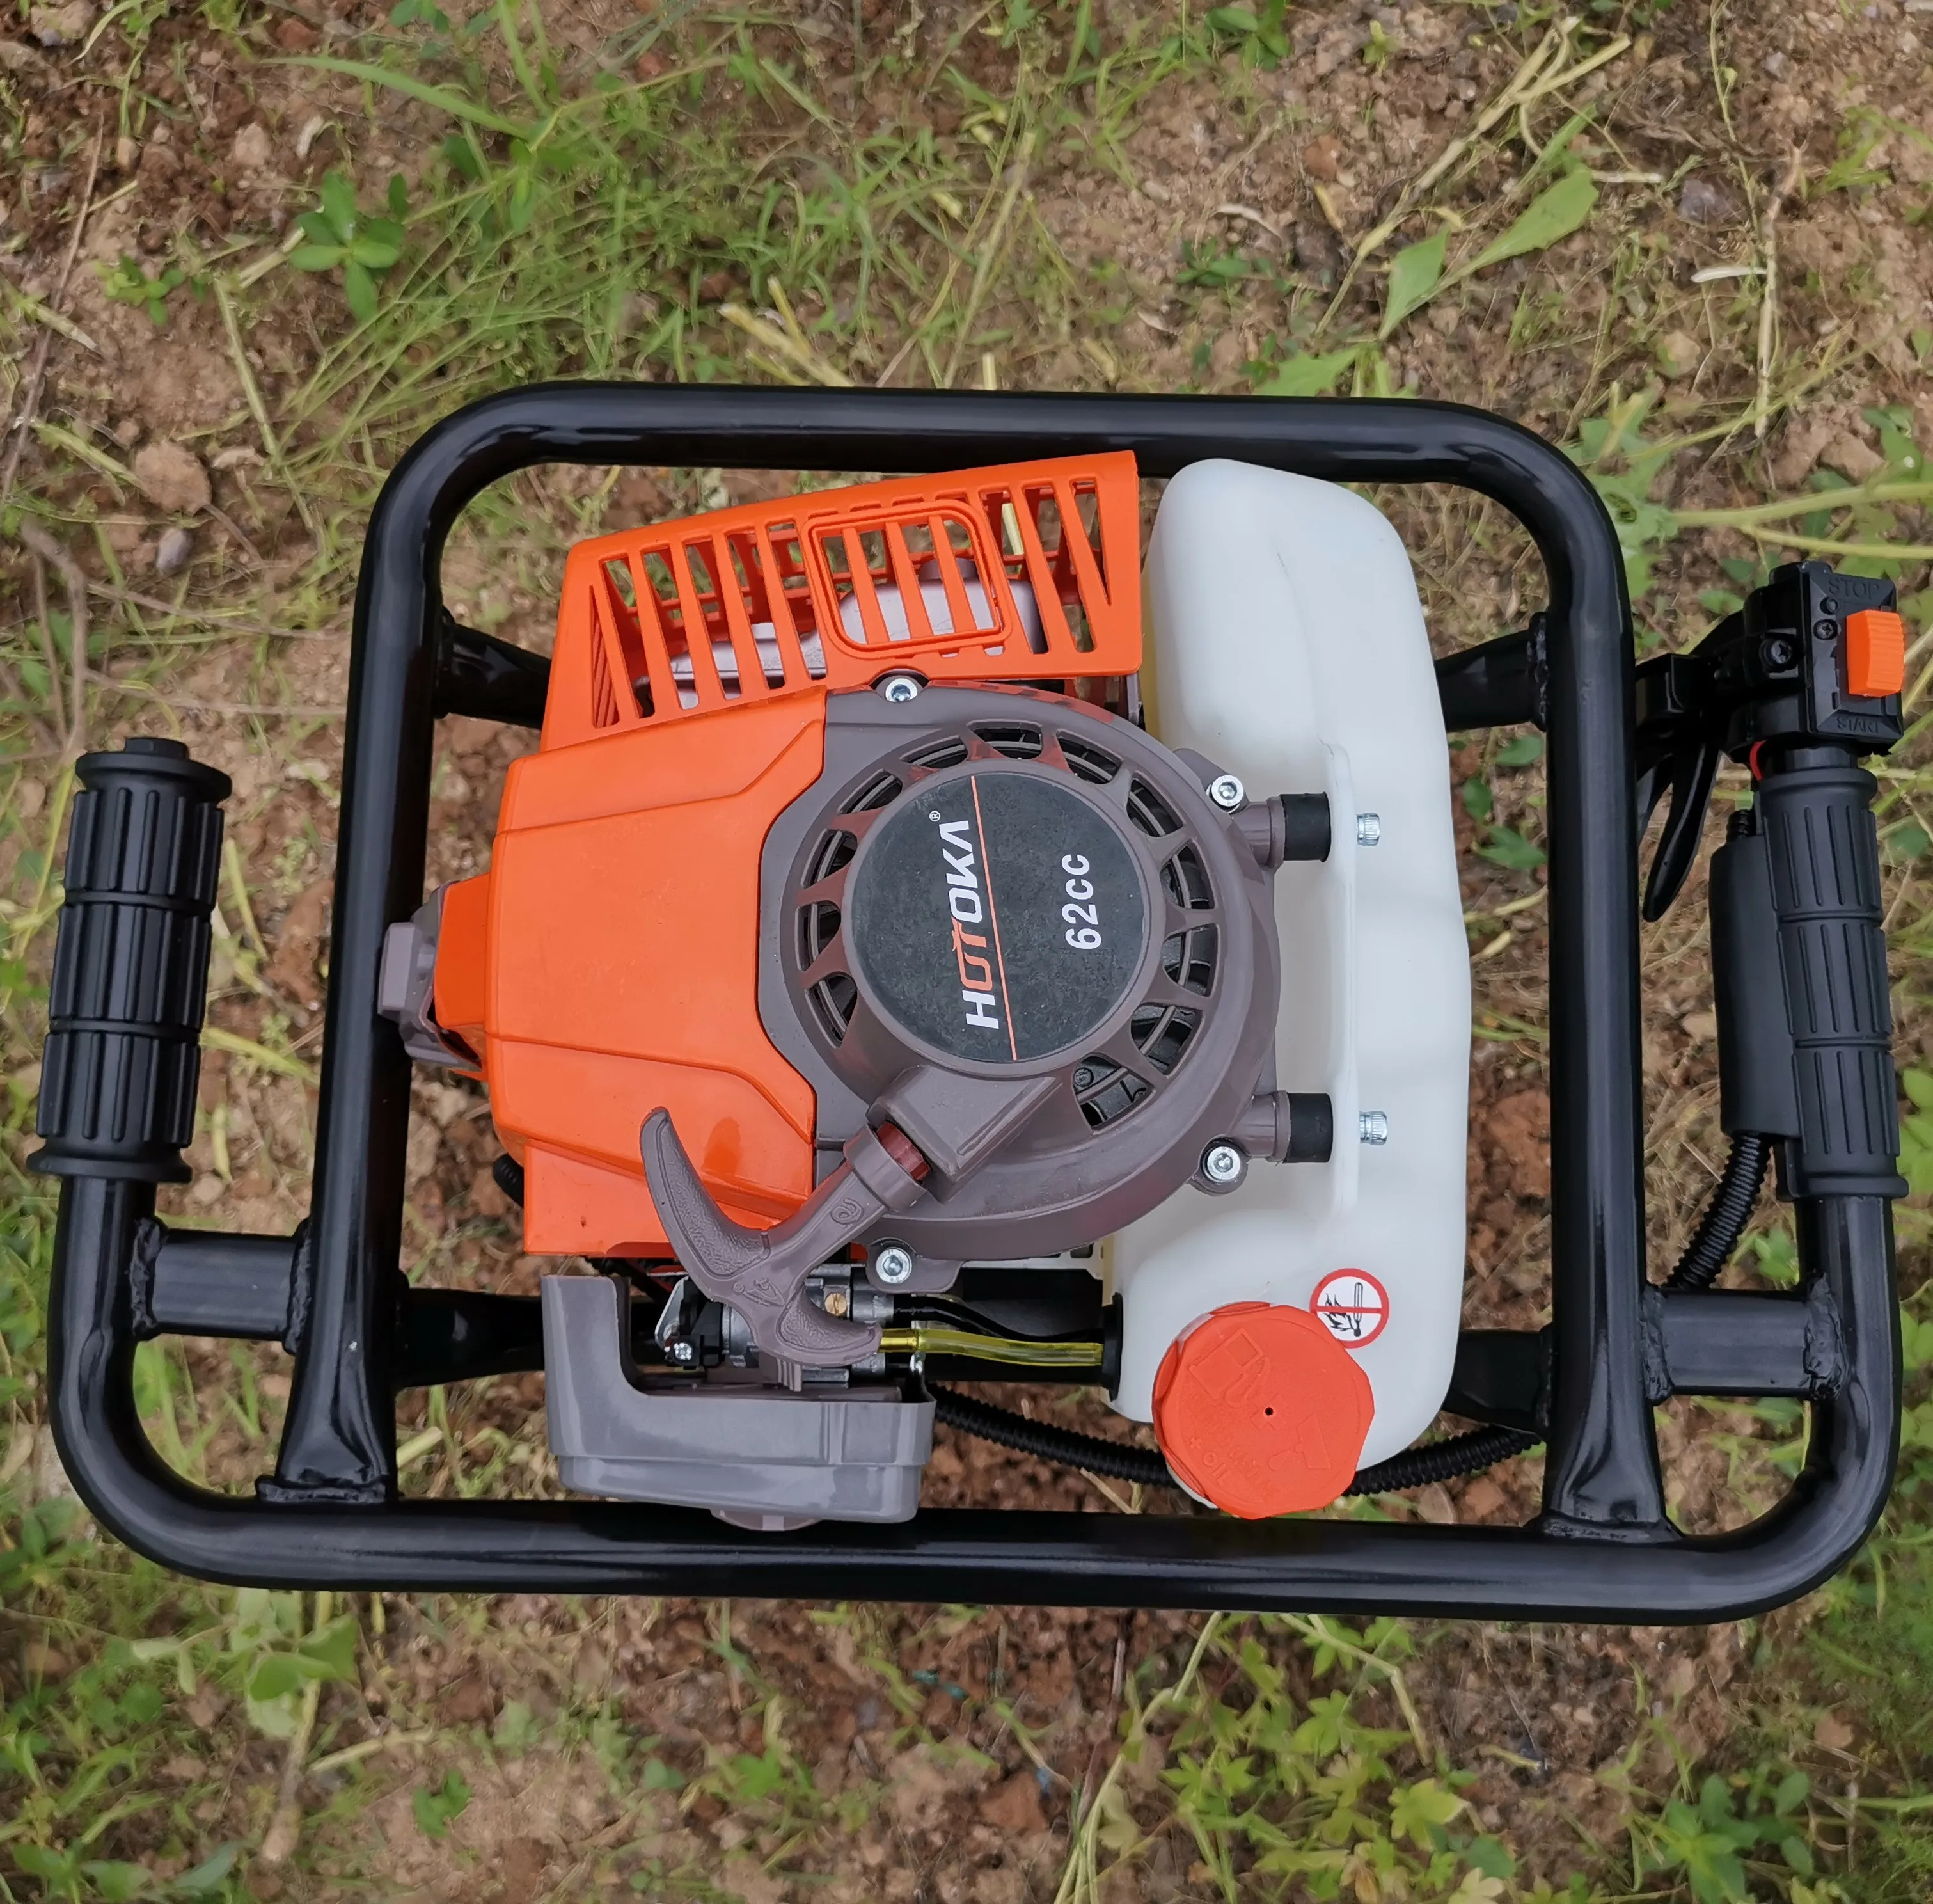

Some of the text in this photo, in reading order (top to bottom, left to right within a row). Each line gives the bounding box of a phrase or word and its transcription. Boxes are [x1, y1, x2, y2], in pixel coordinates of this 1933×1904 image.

[1828, 577, 1880, 600] STOP
[1836, 716, 1879, 734] START
[939, 820, 1000, 1029] HOTOKA
[1061, 853, 1102, 950] 62cc
